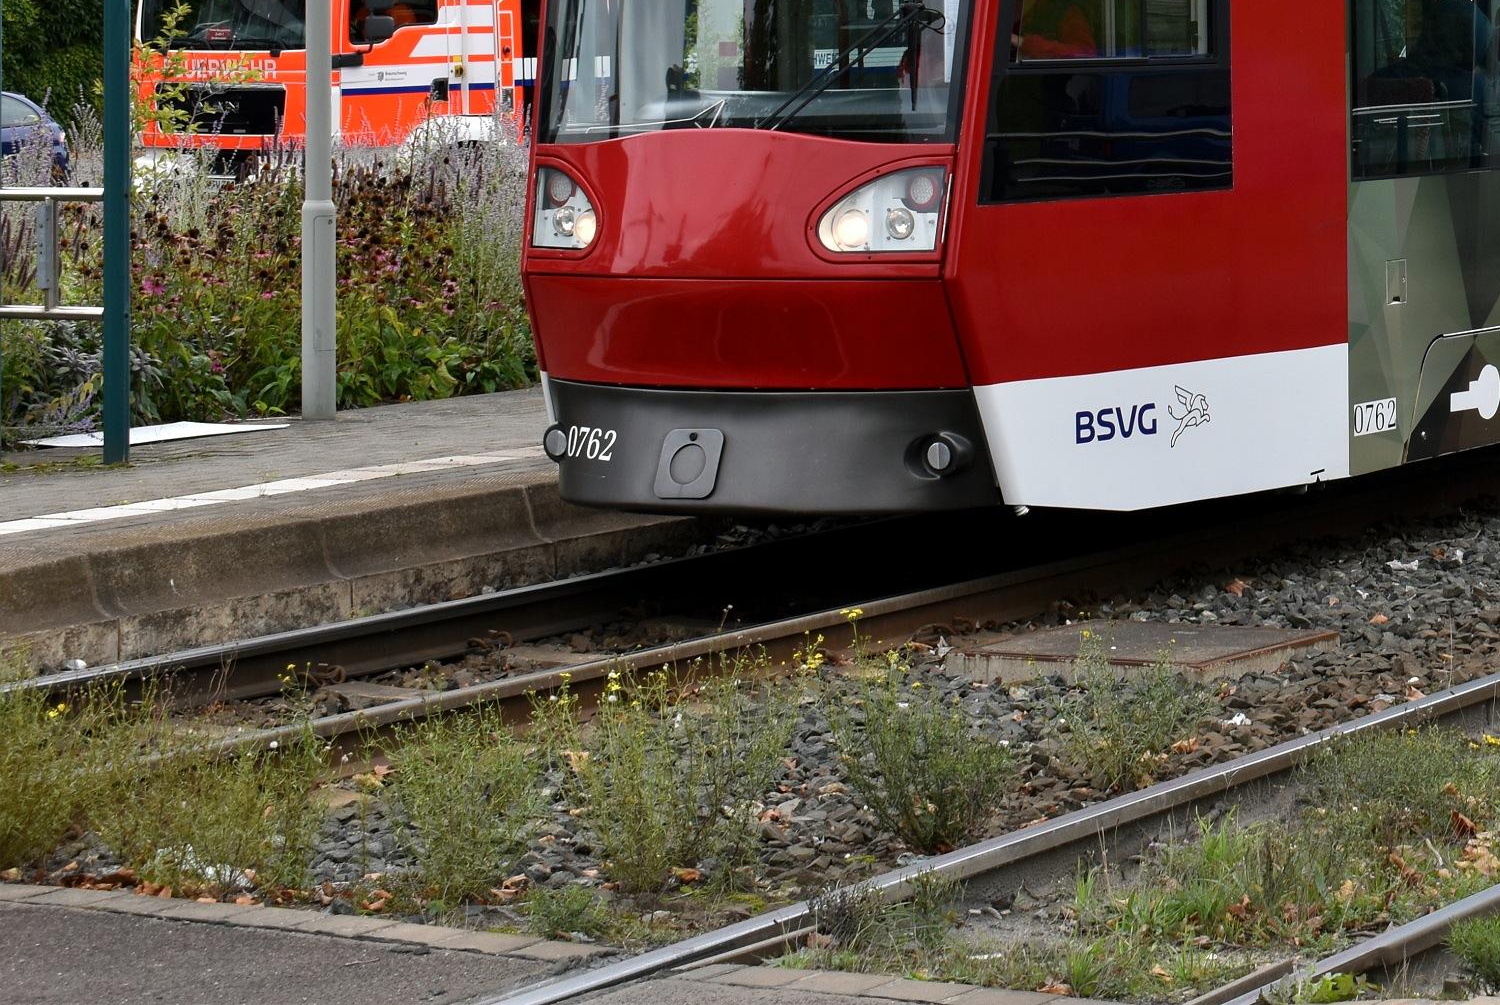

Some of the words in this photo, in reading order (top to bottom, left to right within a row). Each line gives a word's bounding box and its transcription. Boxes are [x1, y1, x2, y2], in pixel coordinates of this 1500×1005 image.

[1075, 402, 1157, 445] BSVG
[1354, 399, 1396, 434] 0762
[567, 425, 617, 462] 0762
